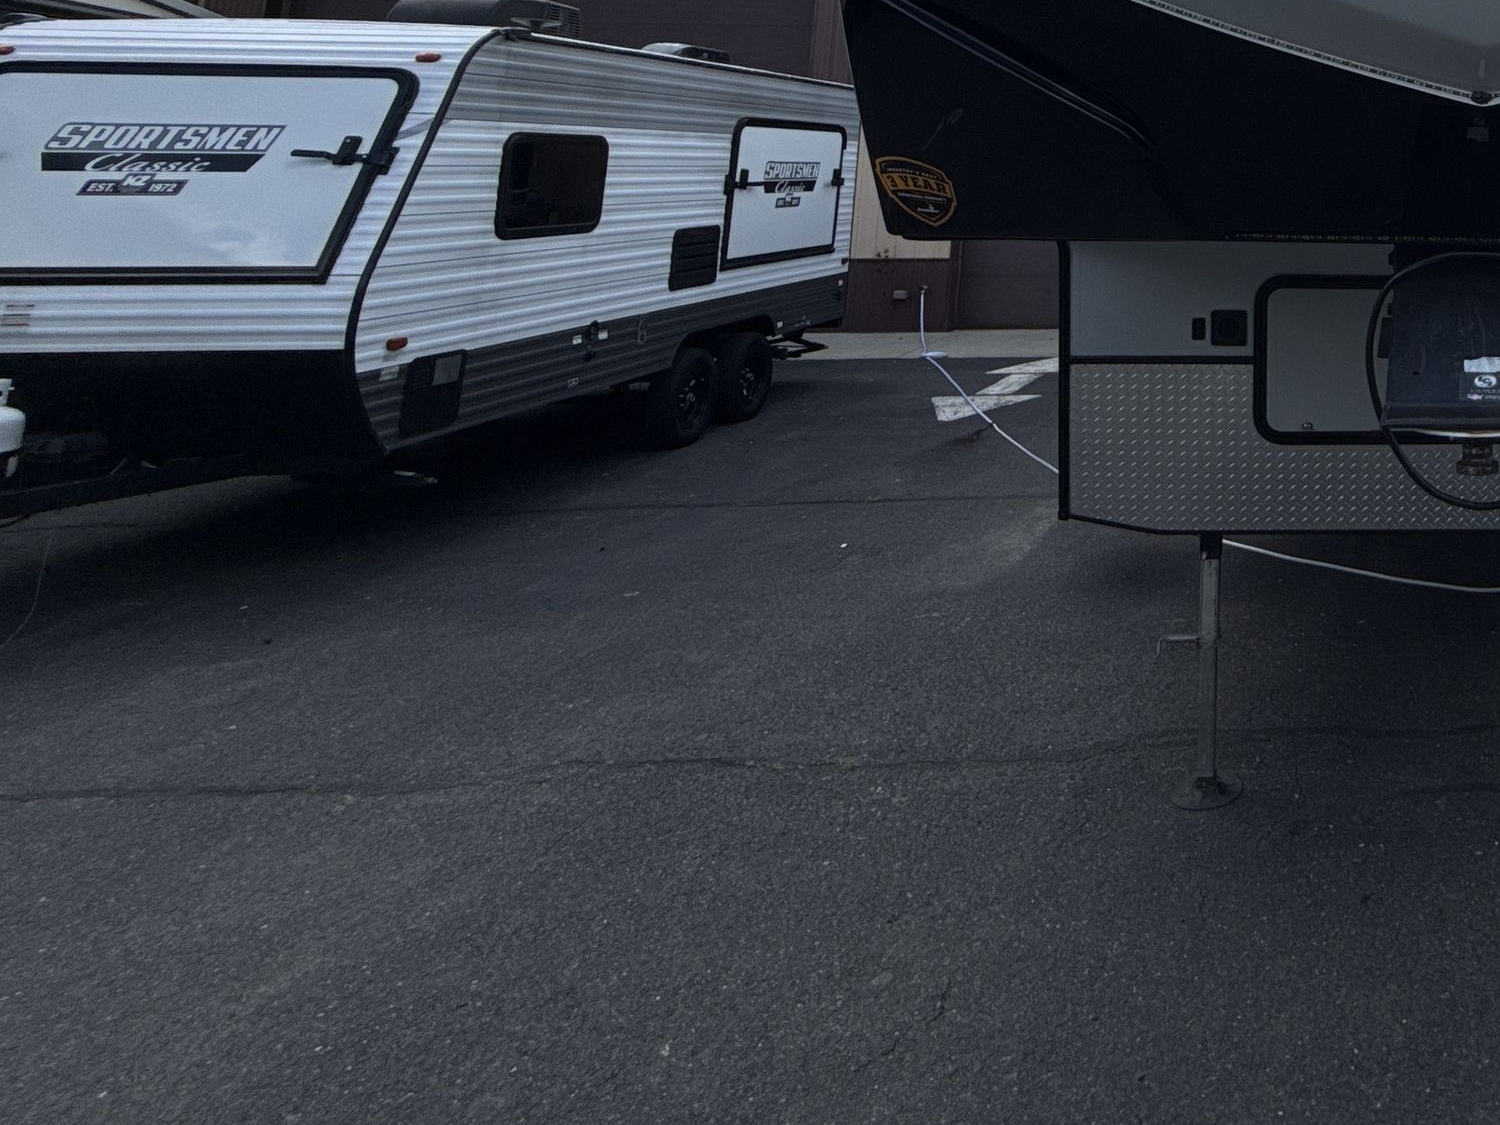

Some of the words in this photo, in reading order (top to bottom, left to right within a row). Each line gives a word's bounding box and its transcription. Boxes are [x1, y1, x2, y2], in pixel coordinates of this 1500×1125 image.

[47, 125, 281, 151] SPORTSMEN
[84, 153, 211, 173] Classic
[764, 162, 820, 178] SPORTSMEN
[86, 183, 114, 192] EST.
[148, 183, 178, 192] 1972
[775, 180, 806, 194] Classic
[887, 174, 898, 188] 3
[898, 175, 948, 194] YEAR
